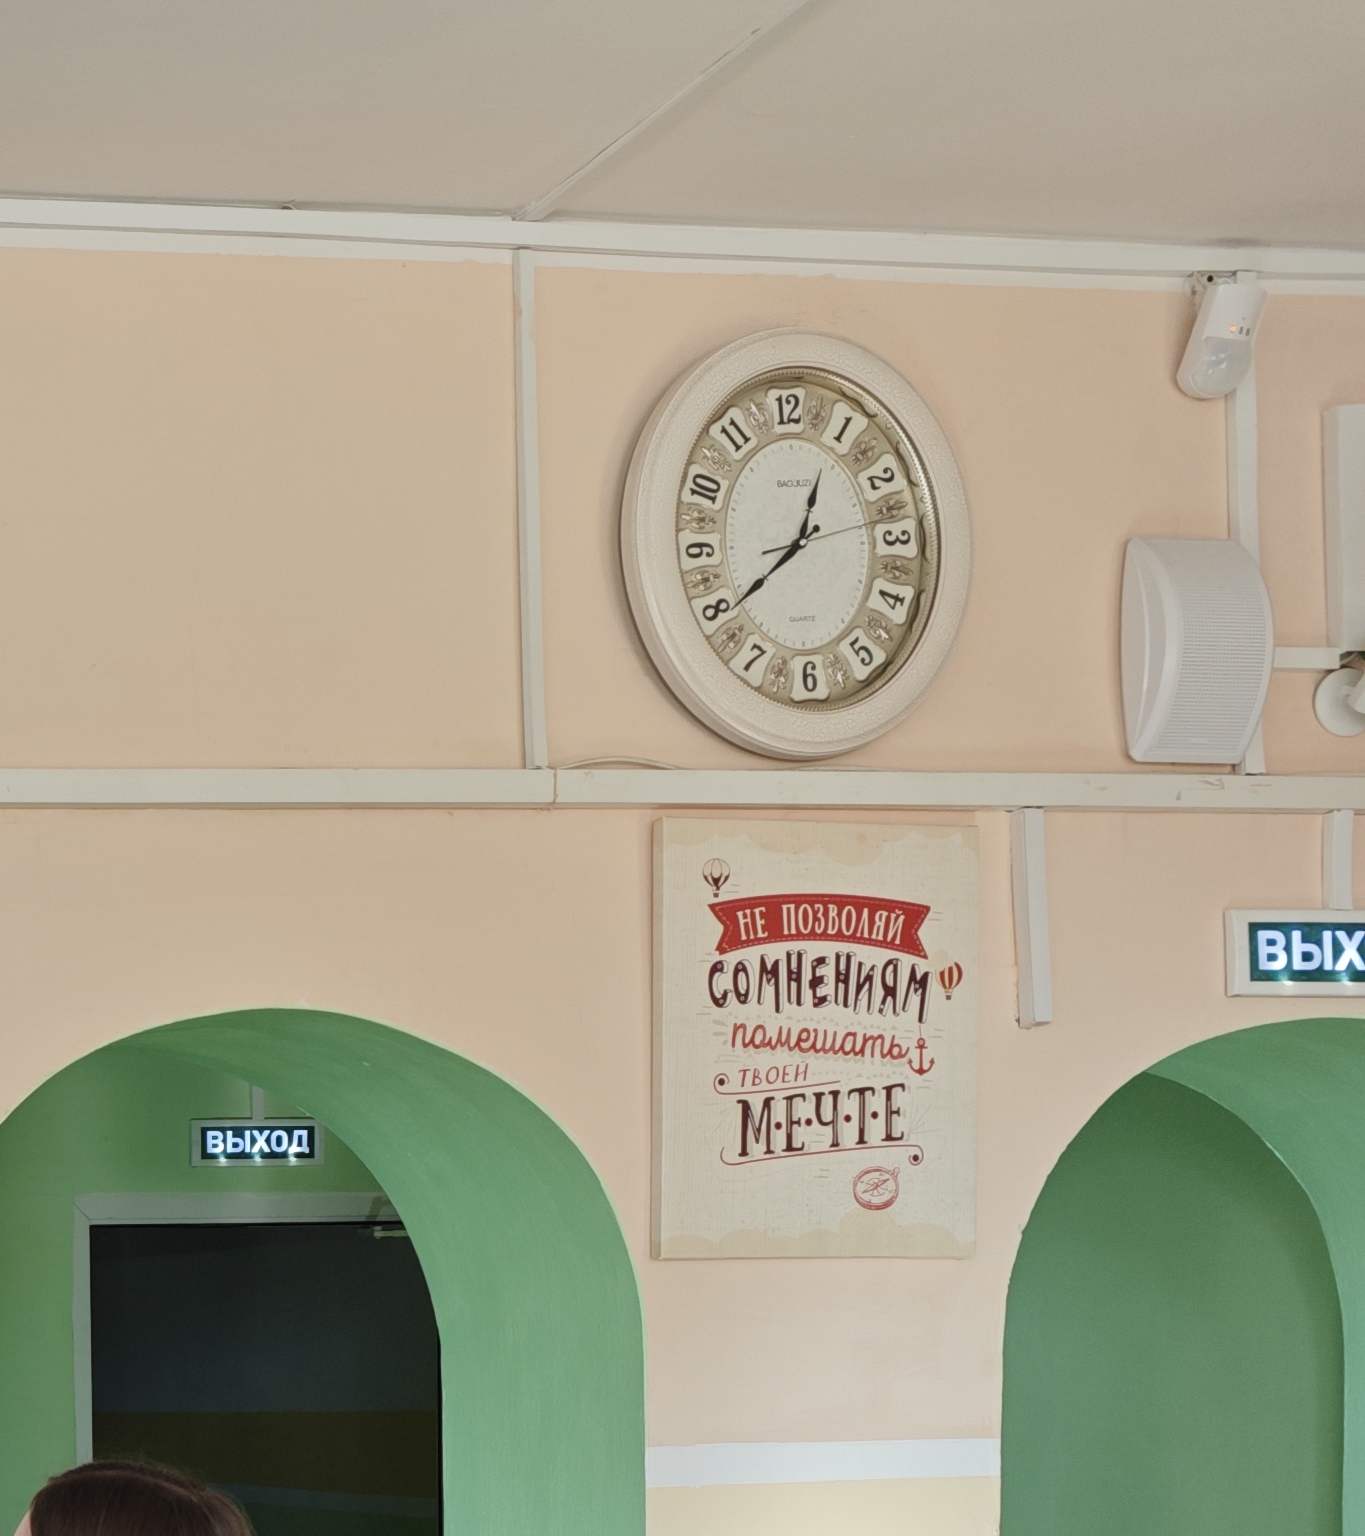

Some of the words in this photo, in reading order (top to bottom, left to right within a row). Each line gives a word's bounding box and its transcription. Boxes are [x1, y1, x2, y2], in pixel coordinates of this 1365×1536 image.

[775, 394, 802, 426] 12
[720, 417, 752, 452] 11
[832, 415, 854, 445] 1
[690, 472, 722, 505] 10
[867, 467, 896, 491] 2
[685, 541, 715, 559] 9
[882, 529, 911, 546] 3
[702, 597, 730, 622] 8
[878, 586, 906, 612] 4
[743, 641, 768, 673] 7
[848, 636, 875, 667] 5
[801, 661, 818, 692] 6
[736, 905, 770, 941] НЕ
[781, 903, 906, 945] ПОЗВОЛЯЙ
[1257, 930, 1365, 971] ВЫХ
[708, 949, 934, 1024] СОМНЕНИЯМ
[731, 1021, 911, 1061] помешать
[738, 1060, 809, 1089] ТВОЕЙ
[206, 1129, 310, 1155] ВЫХОД
